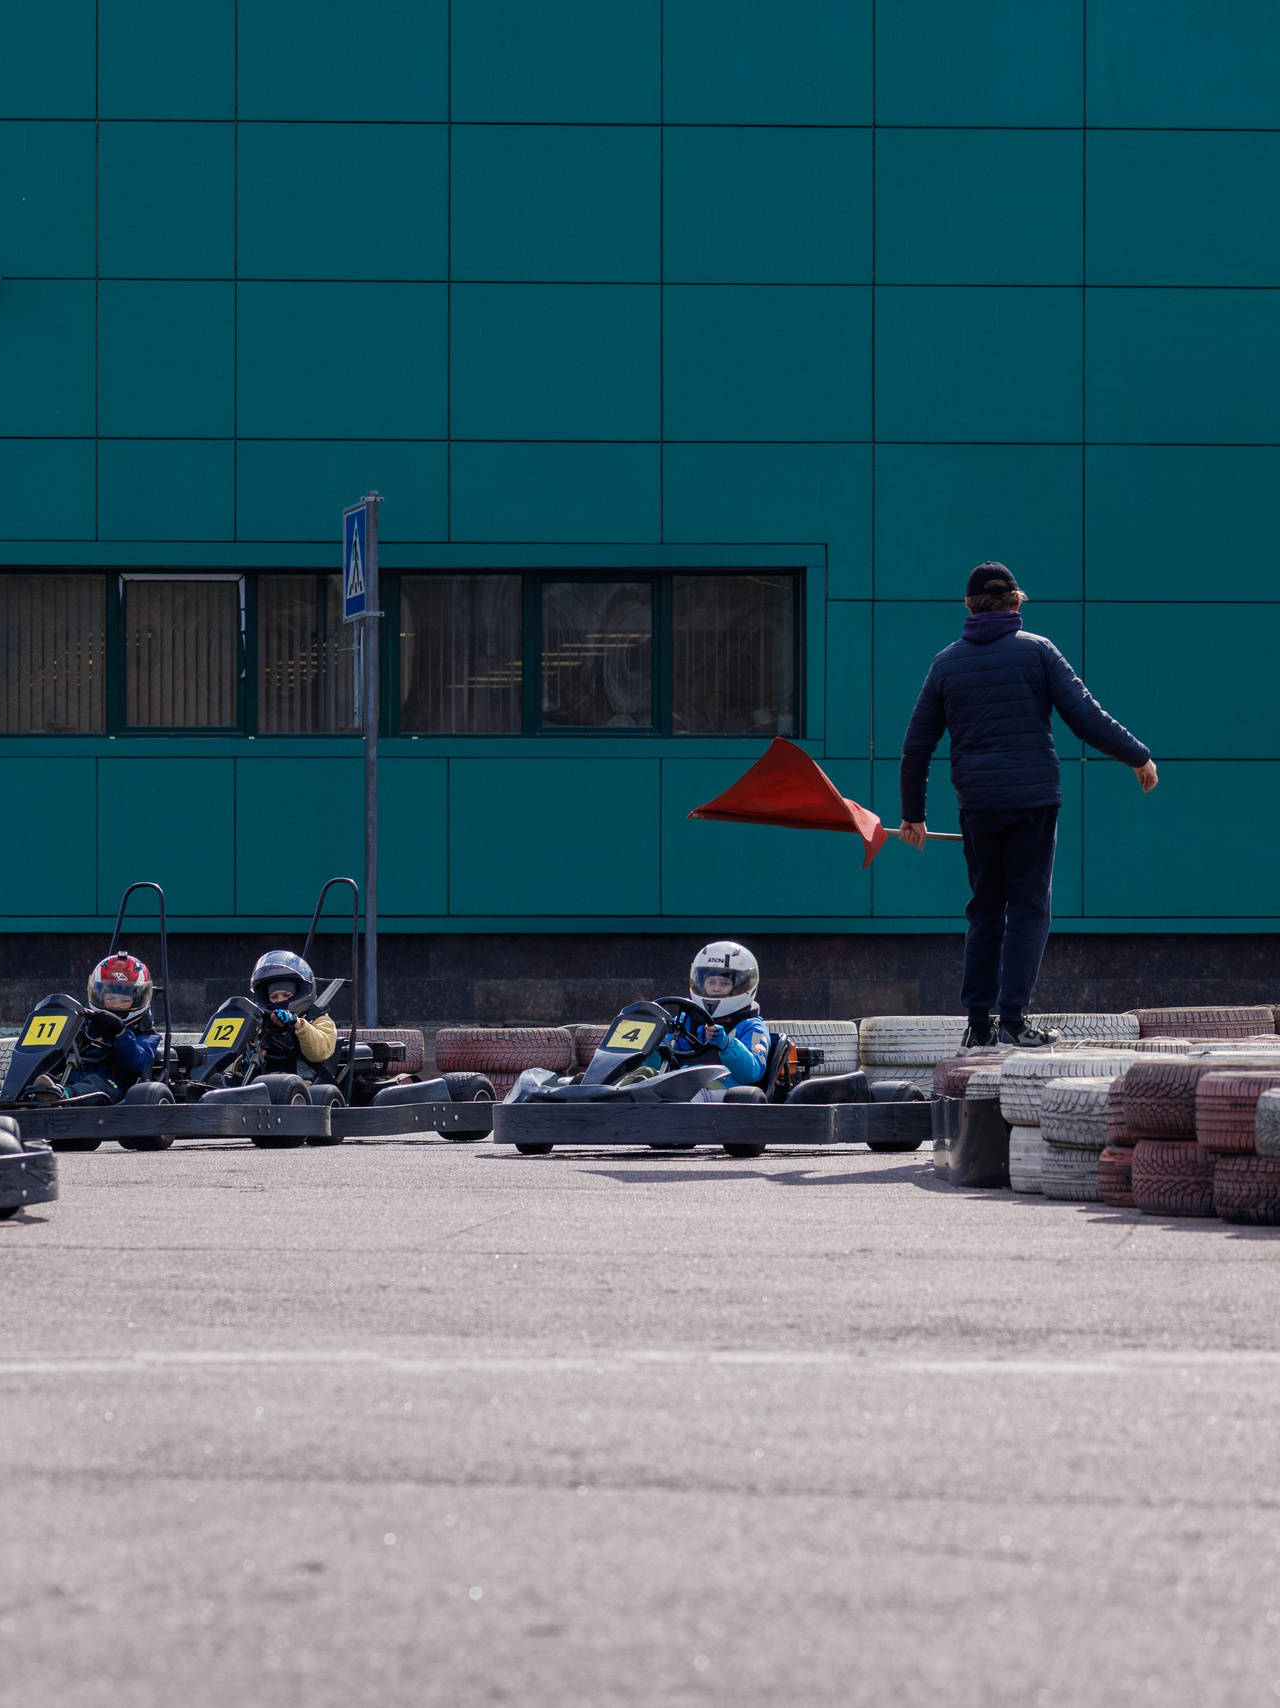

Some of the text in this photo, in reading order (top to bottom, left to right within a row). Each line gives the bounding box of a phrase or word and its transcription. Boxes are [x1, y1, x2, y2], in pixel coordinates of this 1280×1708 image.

[36, 1022, 57, 1038] 11
[213, 1024, 235, 1041] 12
[621, 1028, 641, 1042] 4
